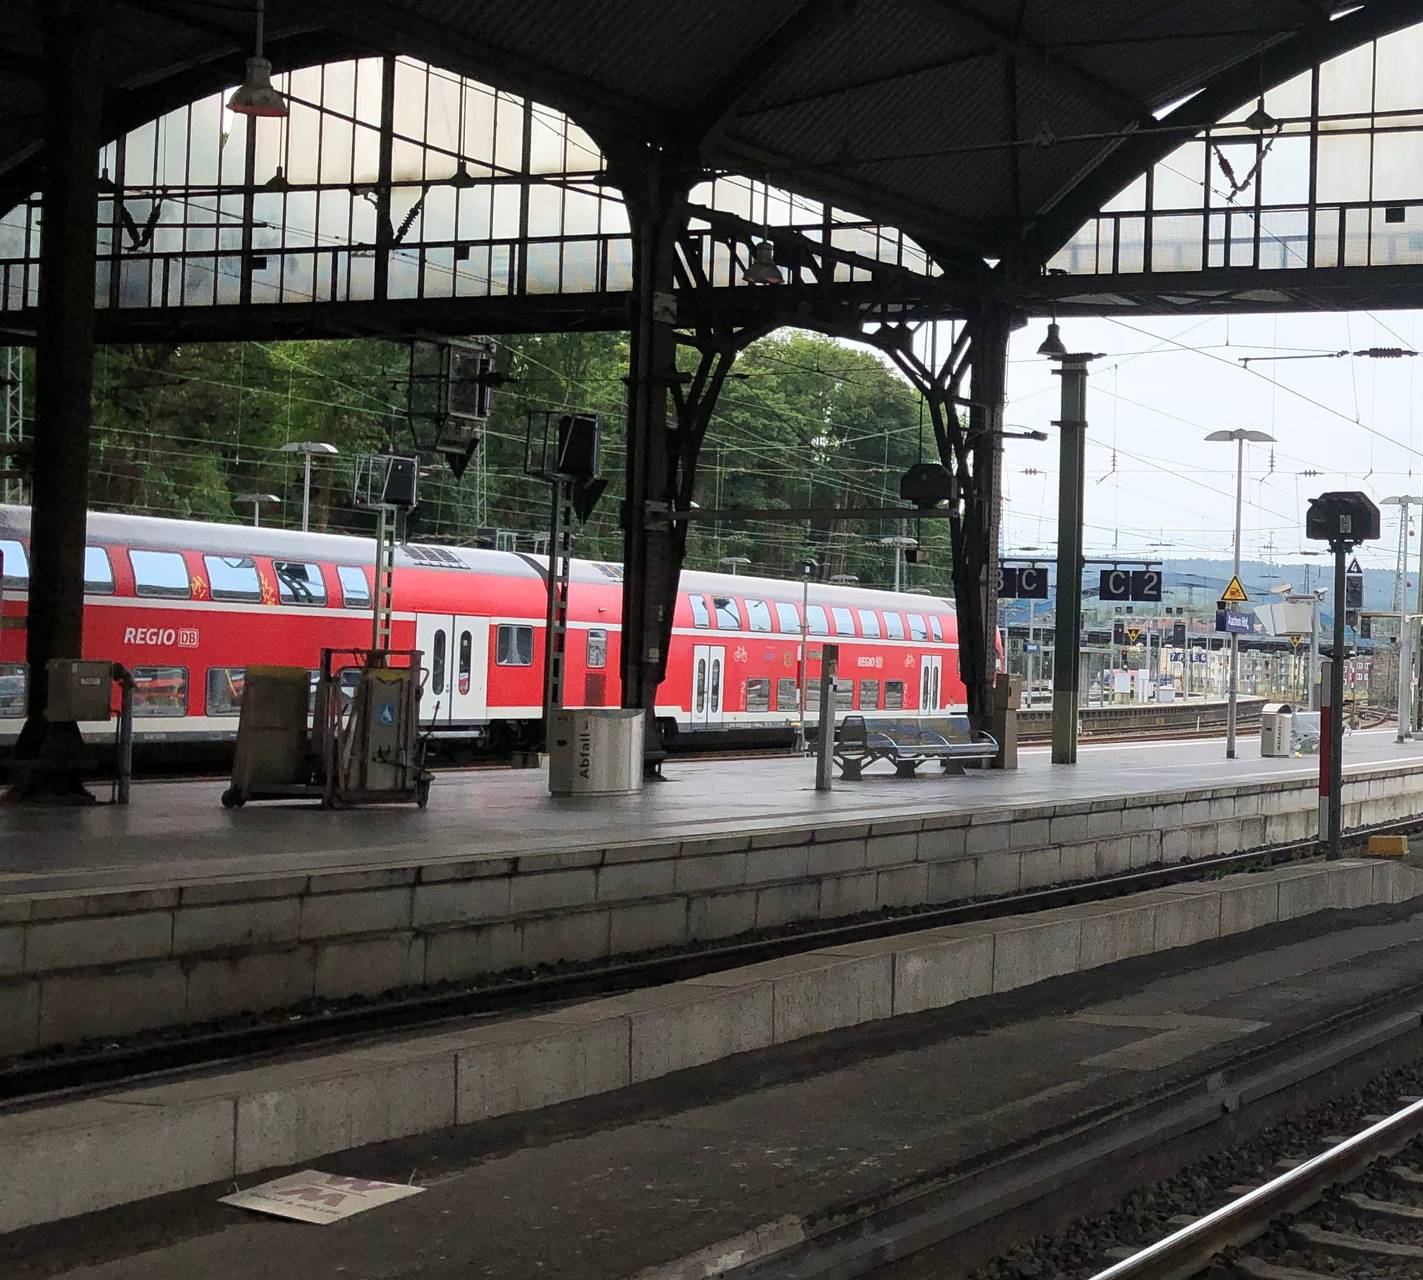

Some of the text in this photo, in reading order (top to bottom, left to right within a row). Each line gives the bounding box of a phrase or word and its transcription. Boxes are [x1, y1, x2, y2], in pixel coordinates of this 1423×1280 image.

[1350, 561, 1358, 573] 4
[1022, 569, 1037, 591] C
[1109, 571, 1158, 595] C 2
[124, 627, 198, 646] REGIO DB
[857, 656, 876, 668] REGIO
[741, 681, 746, 693] 2
[579, 733, 591, 779] Abfall
